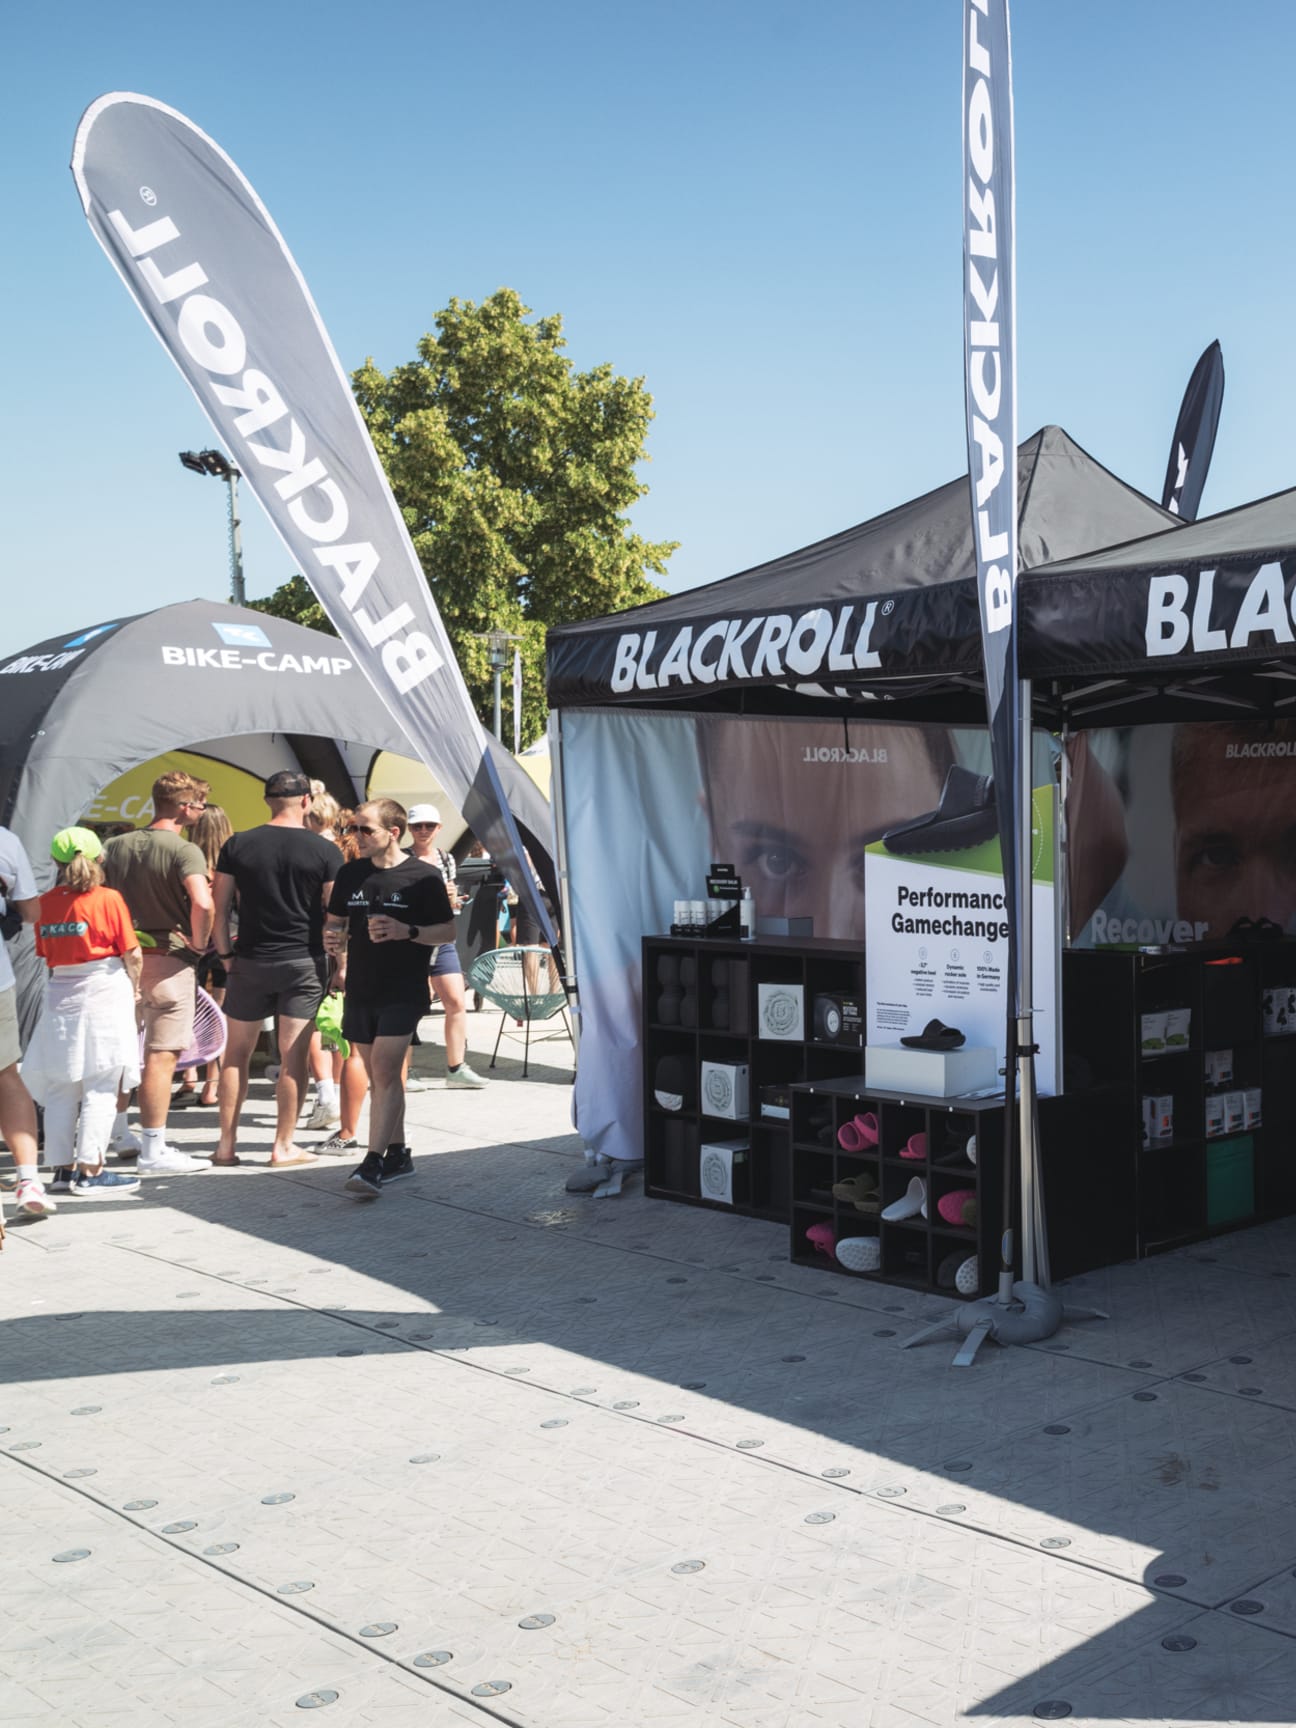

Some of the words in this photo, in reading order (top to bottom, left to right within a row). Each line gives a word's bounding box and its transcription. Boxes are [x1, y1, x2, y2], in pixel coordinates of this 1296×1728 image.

[161, 645, 353, 676] BIKE-CAMP
[898, 886, 1007, 911] Performanc
[892, 912, 1009, 943] Gamechange
[1091, 908, 1209, 946] Recover
